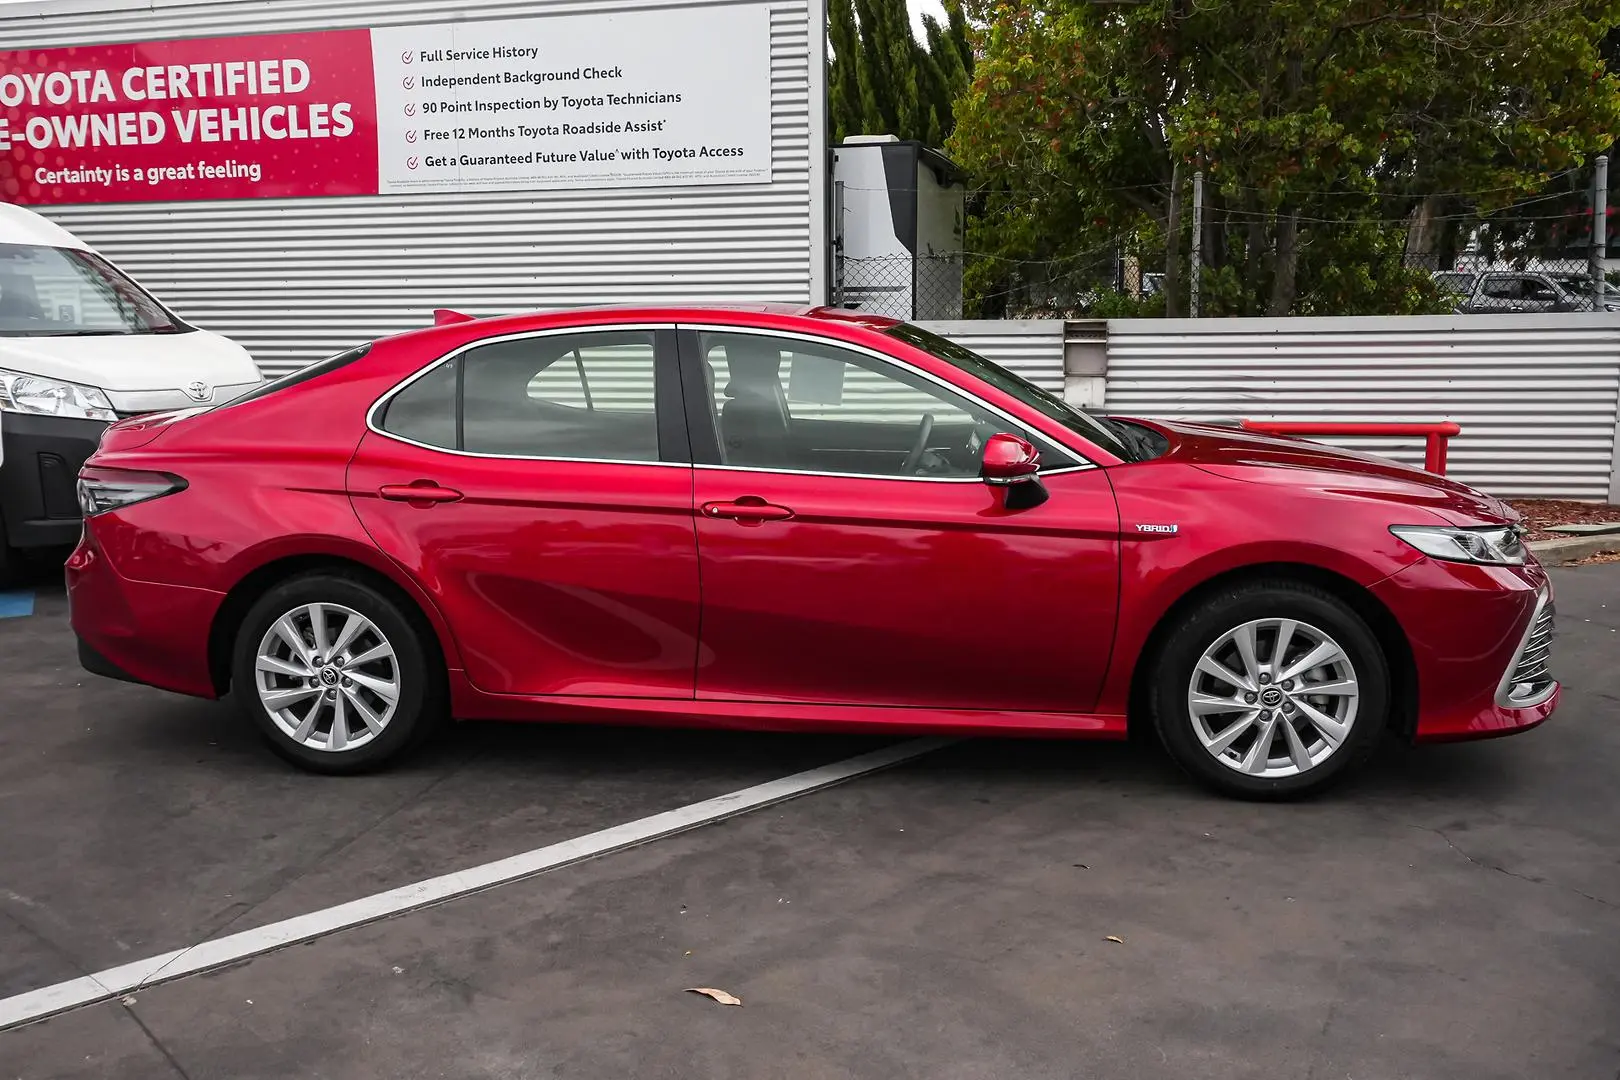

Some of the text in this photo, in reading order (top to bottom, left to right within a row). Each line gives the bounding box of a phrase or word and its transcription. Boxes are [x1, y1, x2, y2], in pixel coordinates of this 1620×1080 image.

[420, 46, 538, 62] Full Service History
[121, 58, 310, 101] CERTIFIED
[421, 66, 623, 88] Independent Background Check
[422, 92, 682, 113] 90 Point Inspection by Toyota Technicians
[171, 102, 354, 143] VEHICLES
[424, 129, 450, 140] Free
[452, 128, 466, 139] 12
[468, 125, 515, 139] Months
[518, 124, 559, 138] Toyota
[562, 122, 622, 135] Roadside
[425, 156, 448, 167] Get
[450, 158, 457, 166] a
[459, 152, 533, 166] Guaranteed
[535, 150, 577, 163] Future
[621, 148, 650, 160] with
[652, 147, 696, 161] Toyota
[699, 146, 744, 158] Access
[35, 160, 262, 186] Certainty is a great feeling
